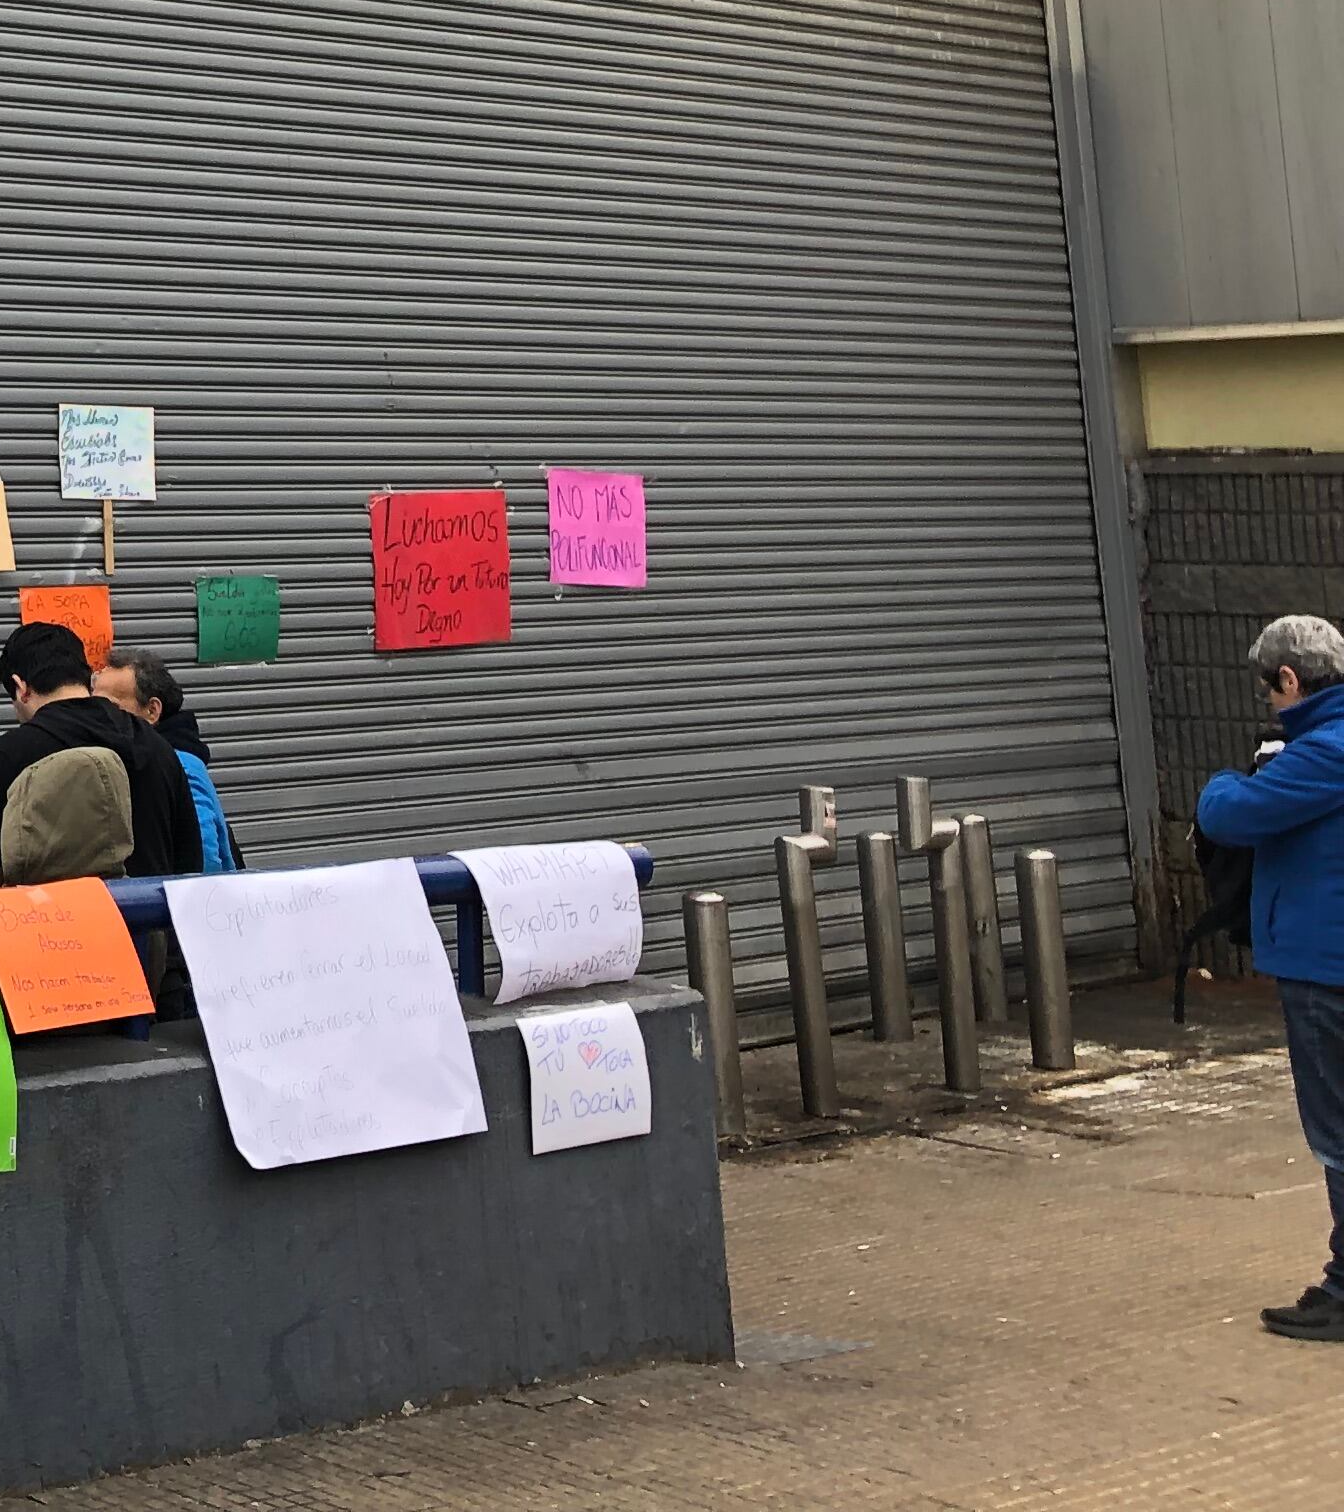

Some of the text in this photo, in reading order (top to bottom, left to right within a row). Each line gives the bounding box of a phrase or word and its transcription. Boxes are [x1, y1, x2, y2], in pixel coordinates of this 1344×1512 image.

[556, 486, 583, 520] NO
[382, 556, 412, 614] Hoy
[448, 574, 469, 594] un
[26, 594, 45, 611] LA
[55, 904, 75, 922] de
[500, 893, 580, 949] Explota
[38, 932, 84, 953] Abusos
[541, 1092, 563, 1127] LA
